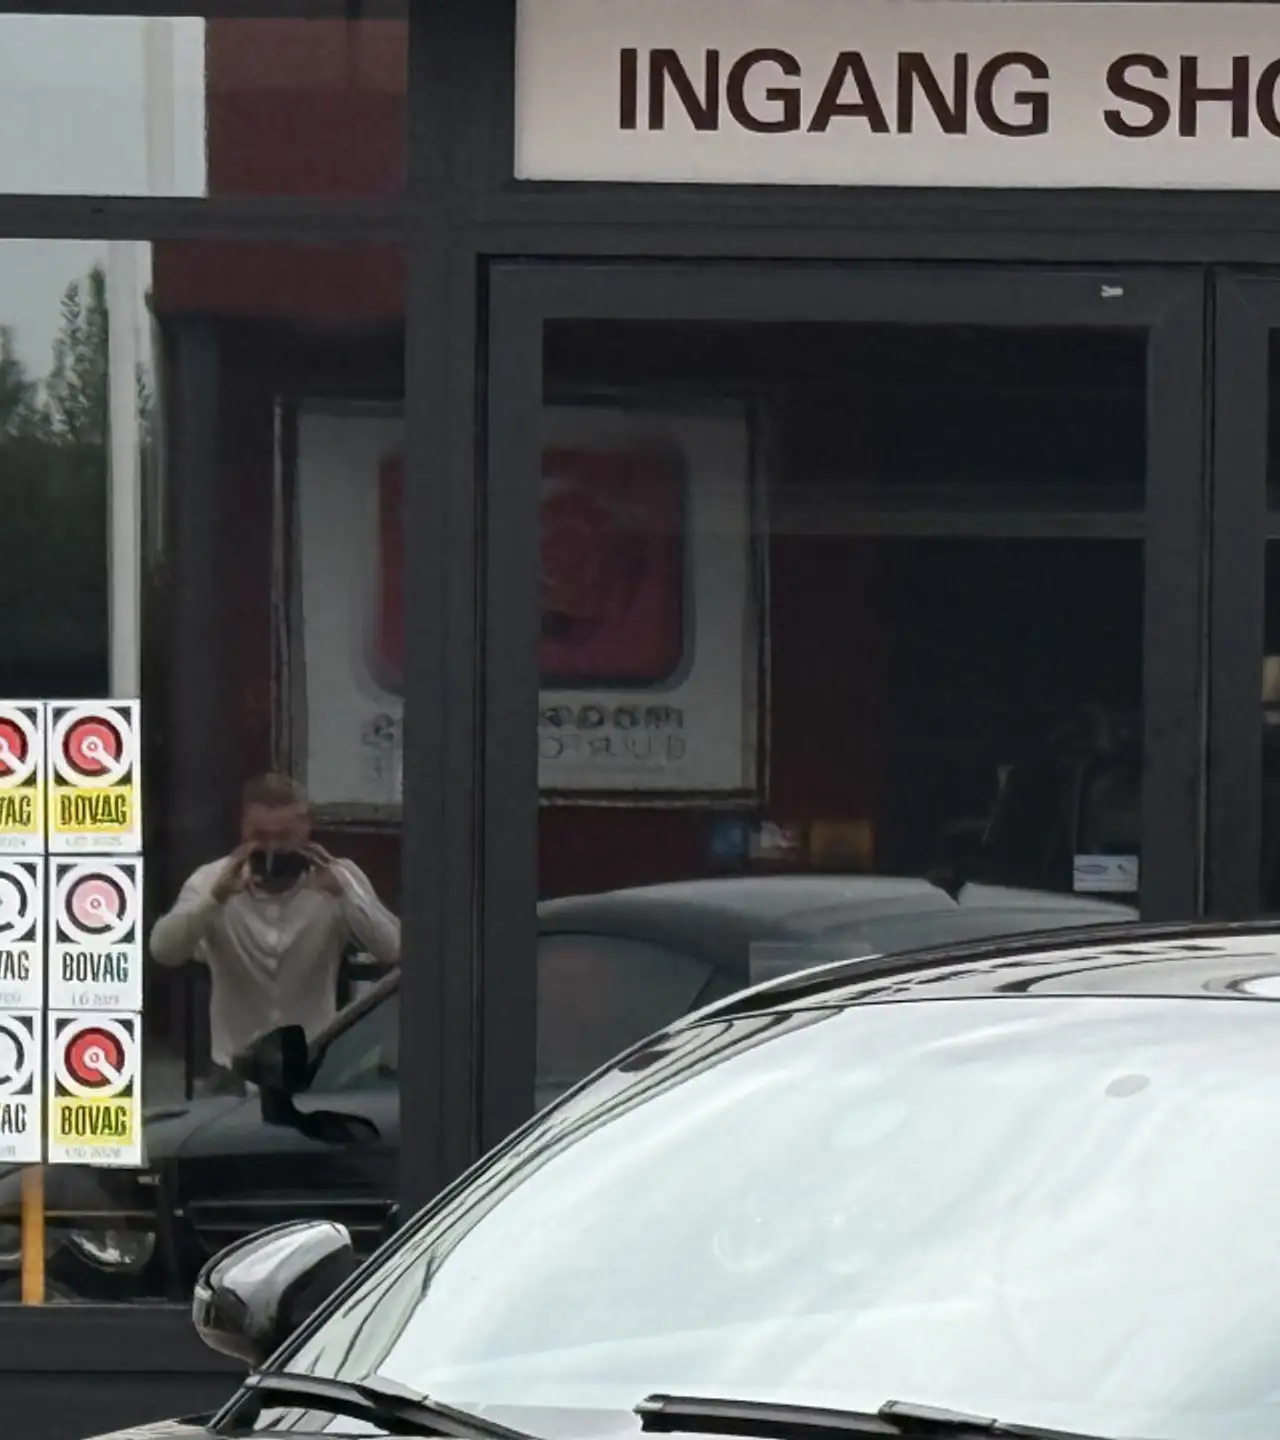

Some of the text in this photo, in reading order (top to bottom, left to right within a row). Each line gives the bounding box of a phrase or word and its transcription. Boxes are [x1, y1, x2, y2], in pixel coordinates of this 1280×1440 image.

[619, 47, 1050, 137] INGANG
[60, 794, 128, 826] BOVAG
[62, 951, 129, 983] BOVAG
[60, 1105, 130, 1137] BOVAG
